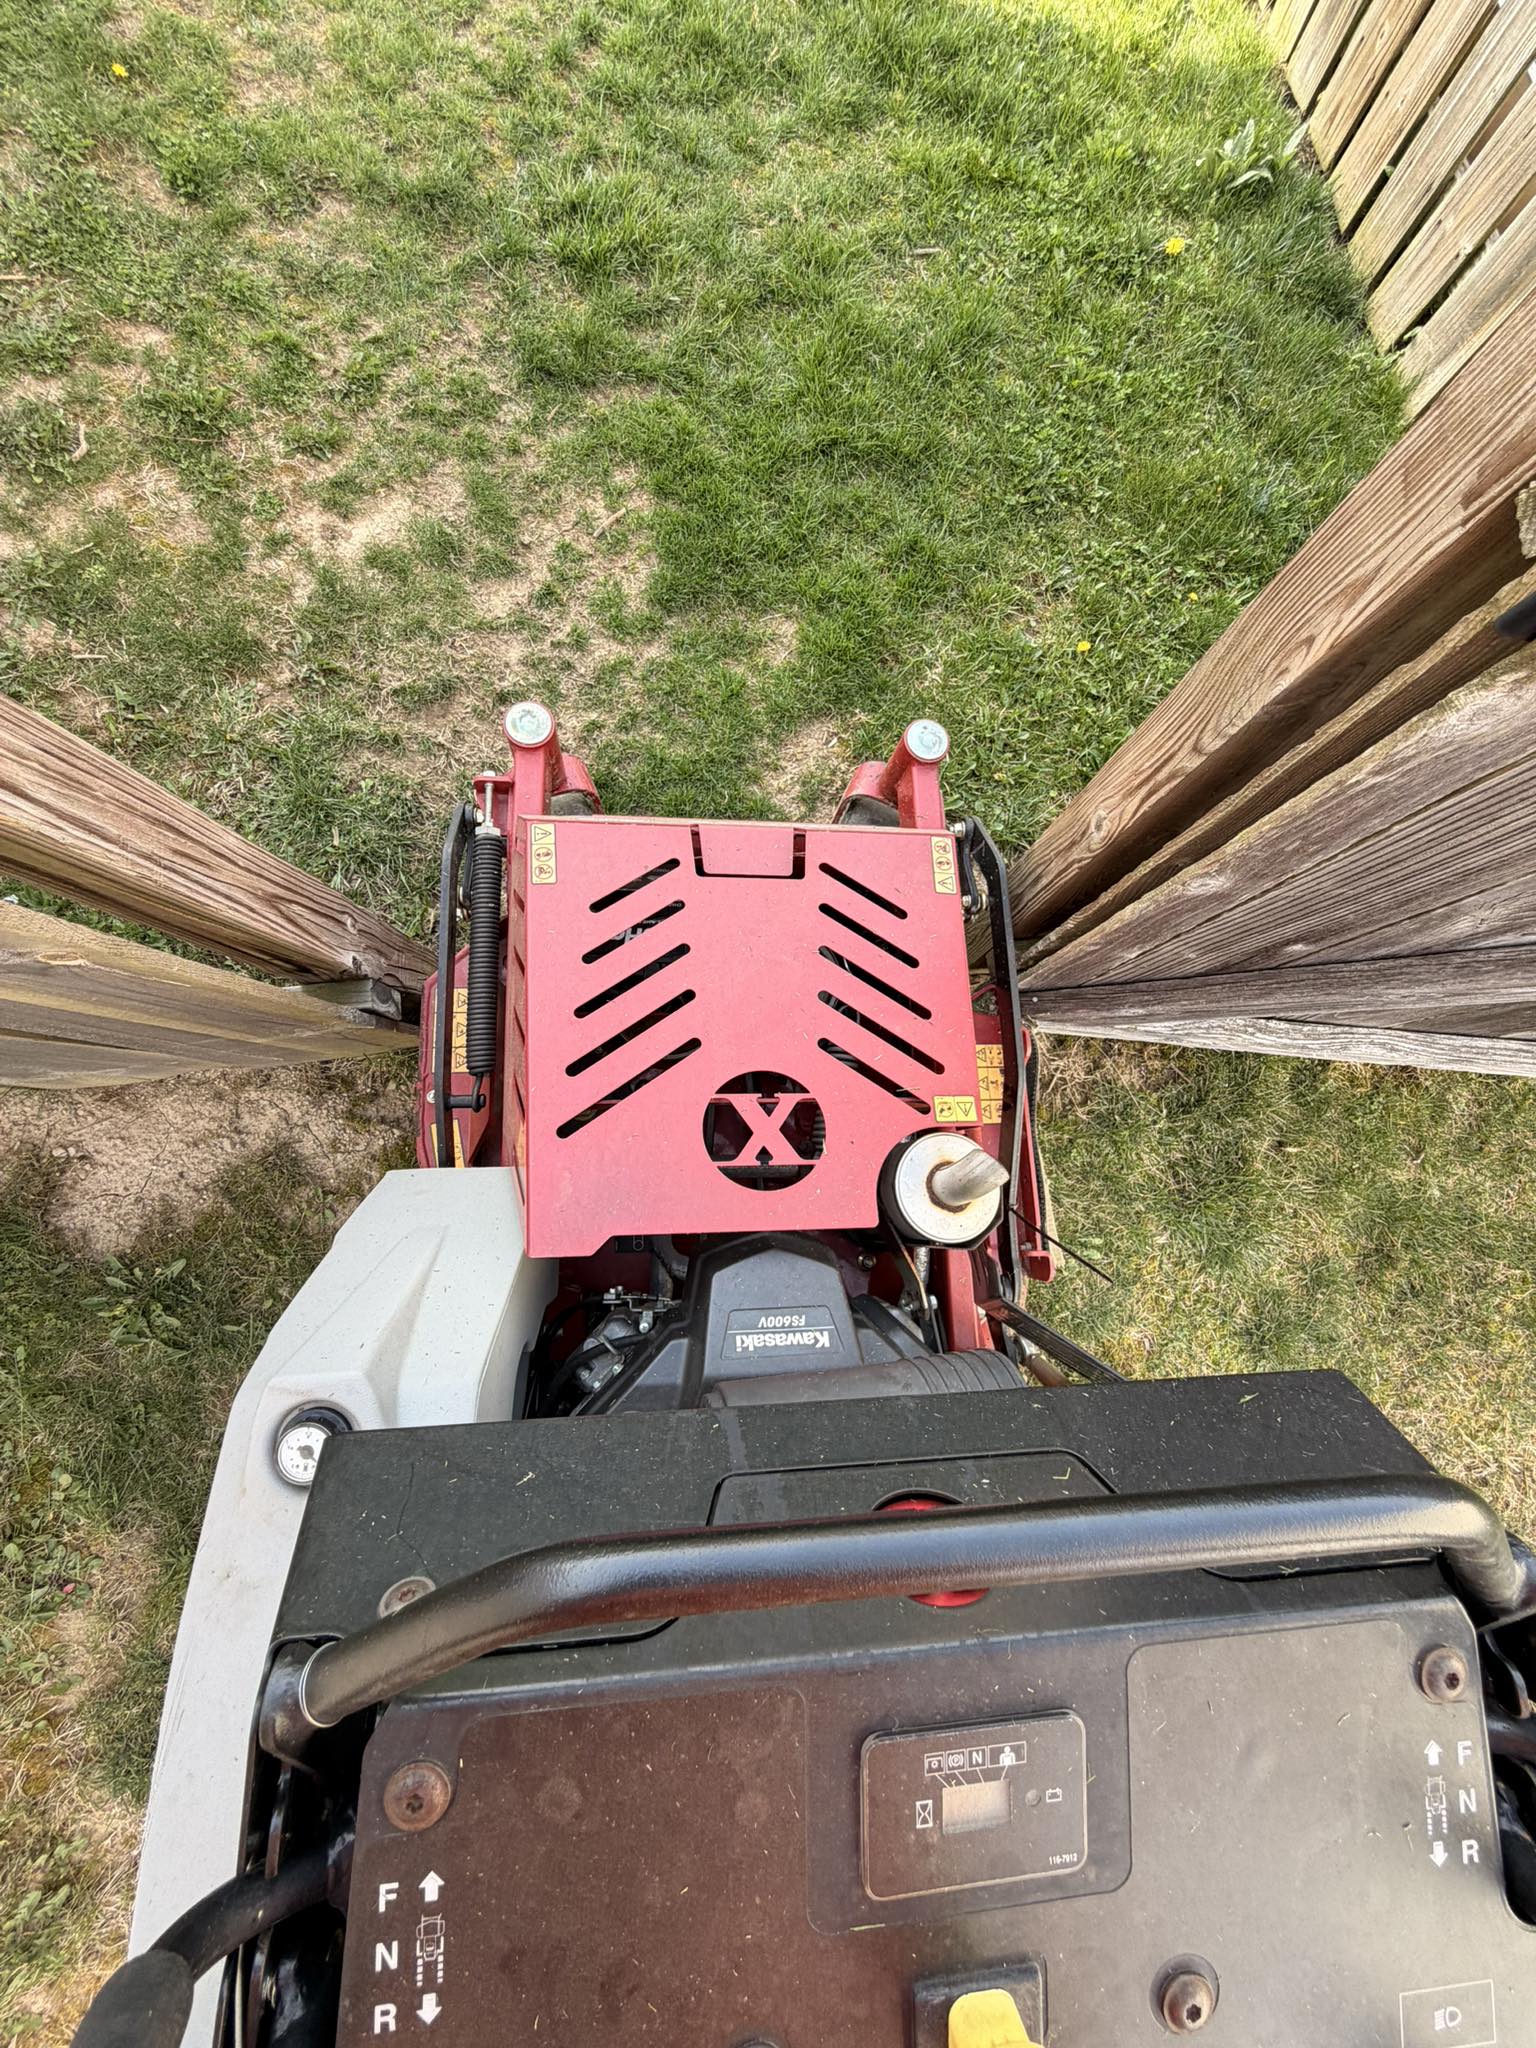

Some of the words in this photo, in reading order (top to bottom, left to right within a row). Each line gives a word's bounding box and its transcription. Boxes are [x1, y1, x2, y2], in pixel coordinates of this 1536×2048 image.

[758, 1314, 806, 1328] FS600V
[735, 1331, 831, 1352] Kawasaki
[972, 1750, 983, 1765] N
[1457, 1740, 1473, 1766] F
[1458, 1787, 1478, 1814] N
[1461, 1839, 1480, 1865] R
[378, 1881, 400, 1913] F
[374, 1939, 399, 1973] N
[373, 2002, 397, 2035] R
